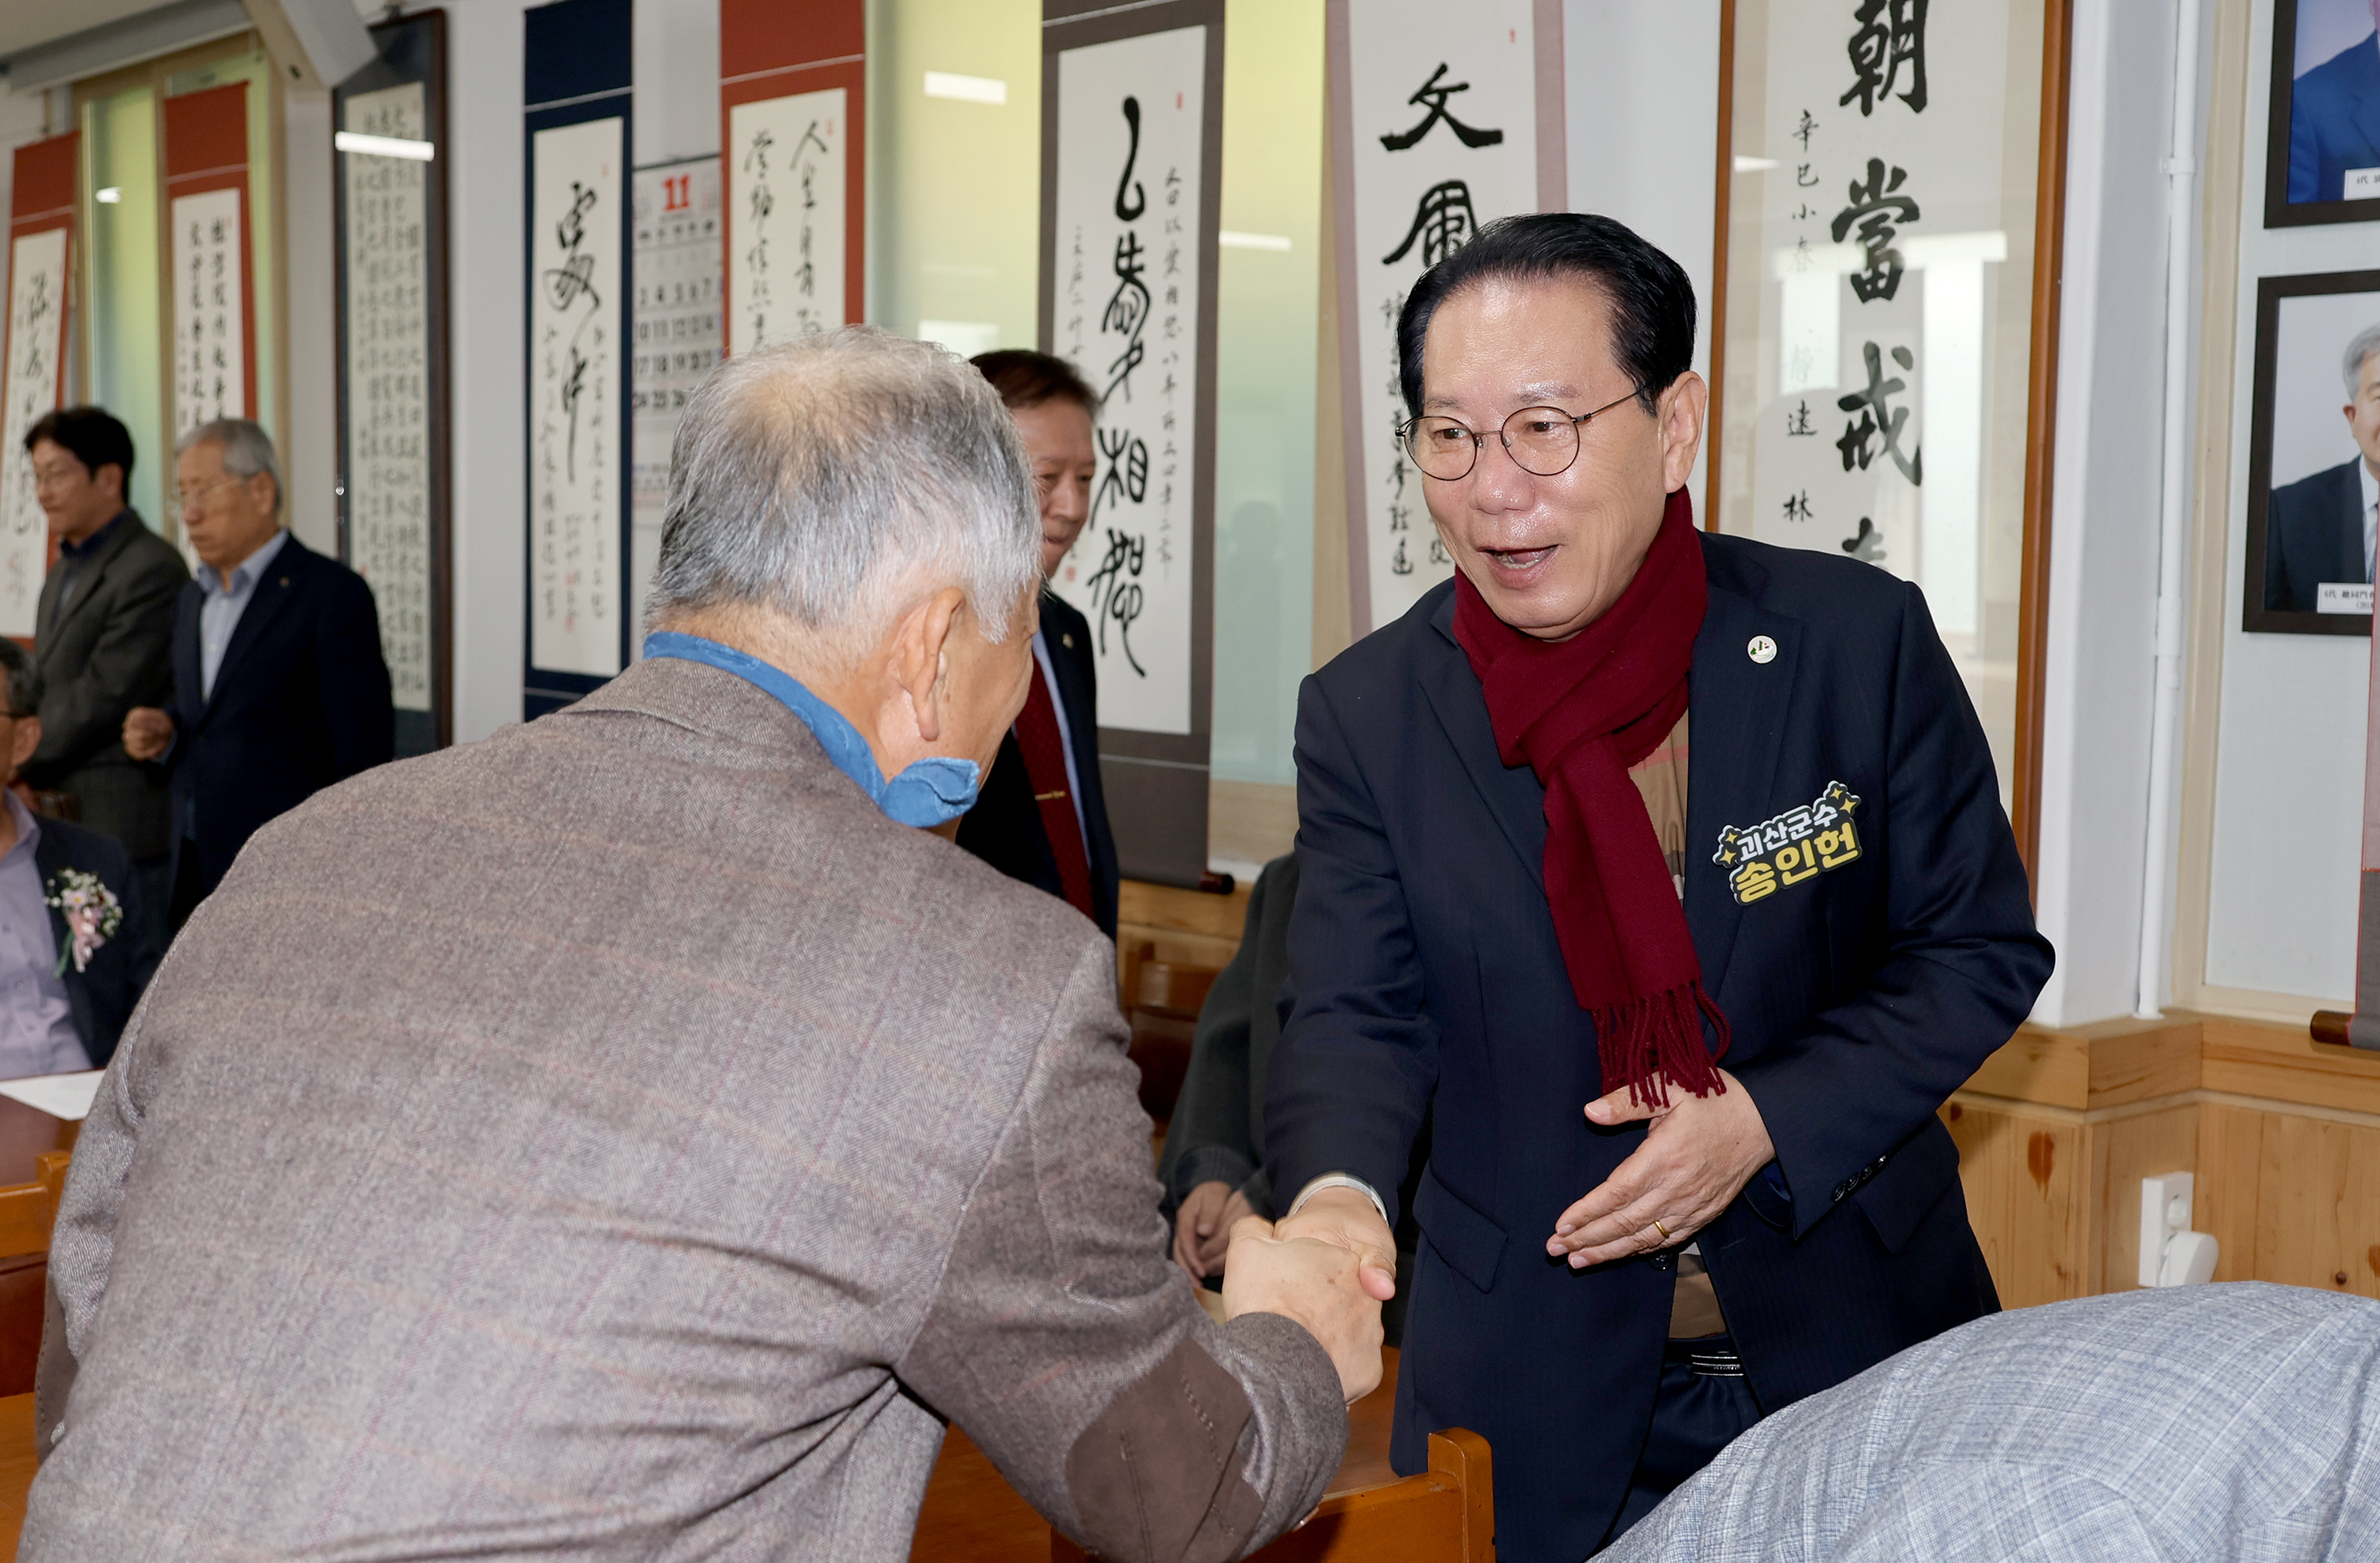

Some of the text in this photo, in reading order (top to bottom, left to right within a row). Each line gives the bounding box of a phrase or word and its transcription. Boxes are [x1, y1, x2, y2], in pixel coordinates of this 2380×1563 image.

[660, 173, 692, 213] 11
[1737, 803, 1837, 861] 괴산군수
[1736, 820, 1858, 904] 송인헌
